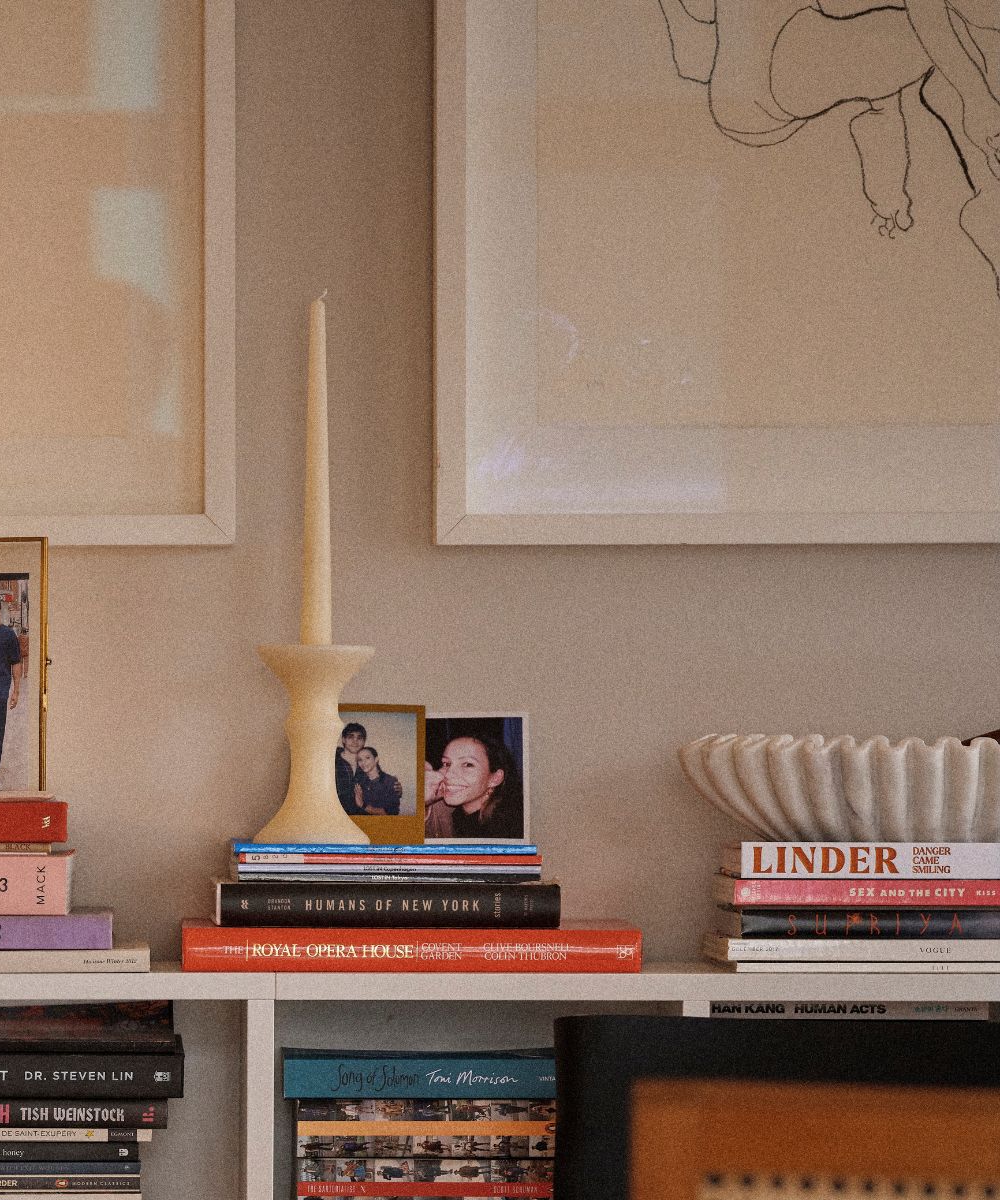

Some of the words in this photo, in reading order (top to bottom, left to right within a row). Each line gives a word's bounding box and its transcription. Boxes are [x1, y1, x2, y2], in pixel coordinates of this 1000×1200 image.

[912, 847, 951, 856] DANGER
[751, 846, 900, 874] LINDER
[912, 856, 940, 865] CAME
[912, 865, 951, 874] SMILING
[36, 866, 46, 905] MACK
[849, 887, 875, 898] SEX
[880, 889, 906, 898] AND
[909, 889, 931, 898] THE
[934, 887, 966, 898] CITY
[305, 899, 366, 912] HUMANS
[375, 900, 392, 912] OF
[402, 900, 433, 912] NEW
[442, 900, 481, 912] YORK
[494, 892, 502, 919] stories
[787, 912, 964, 937] SUPRIYA
[223, 945, 244, 955] THE
[252, 943, 302, 959] ROYAL
[306, 943, 358, 959] OPERA
[362, 944, 415, 959] HOUSE
[421, 943, 463, 952] COVENT
[483, 943, 513, 952] CLIVE
[515, 943, 569, 952] BOURSNELL
[421, 951, 463, 961] GARDEN
[484, 951, 516, 961] COLIN
[519, 951, 567, 961] THUBRON
[711, 1003, 742, 1014] HAN
[744, 1003, 785, 1014] KANG
[794, 1003, 849, 1015] HUMAN
[850, 1003, 887, 1015] ACTS
[24, 1071, 47, 1081] DR.
[52, 1071, 106, 1081] STEVEN
[112, 1071, 134, 1081] LIN
[330, 1063, 363, 1092] Song
[375, 1064, 419, 1092] Solomon
[425, 1068, 452, 1085] Toni
[456, 1070, 519, 1085] Morrison
[20, 1107, 49, 1121] TISH
[53, 1107, 125, 1122] WEINSTOCK
[14, 1128, 77, 1138] SAINT-EXUPÉRY
[3, 1148, 25, 1158] honey
